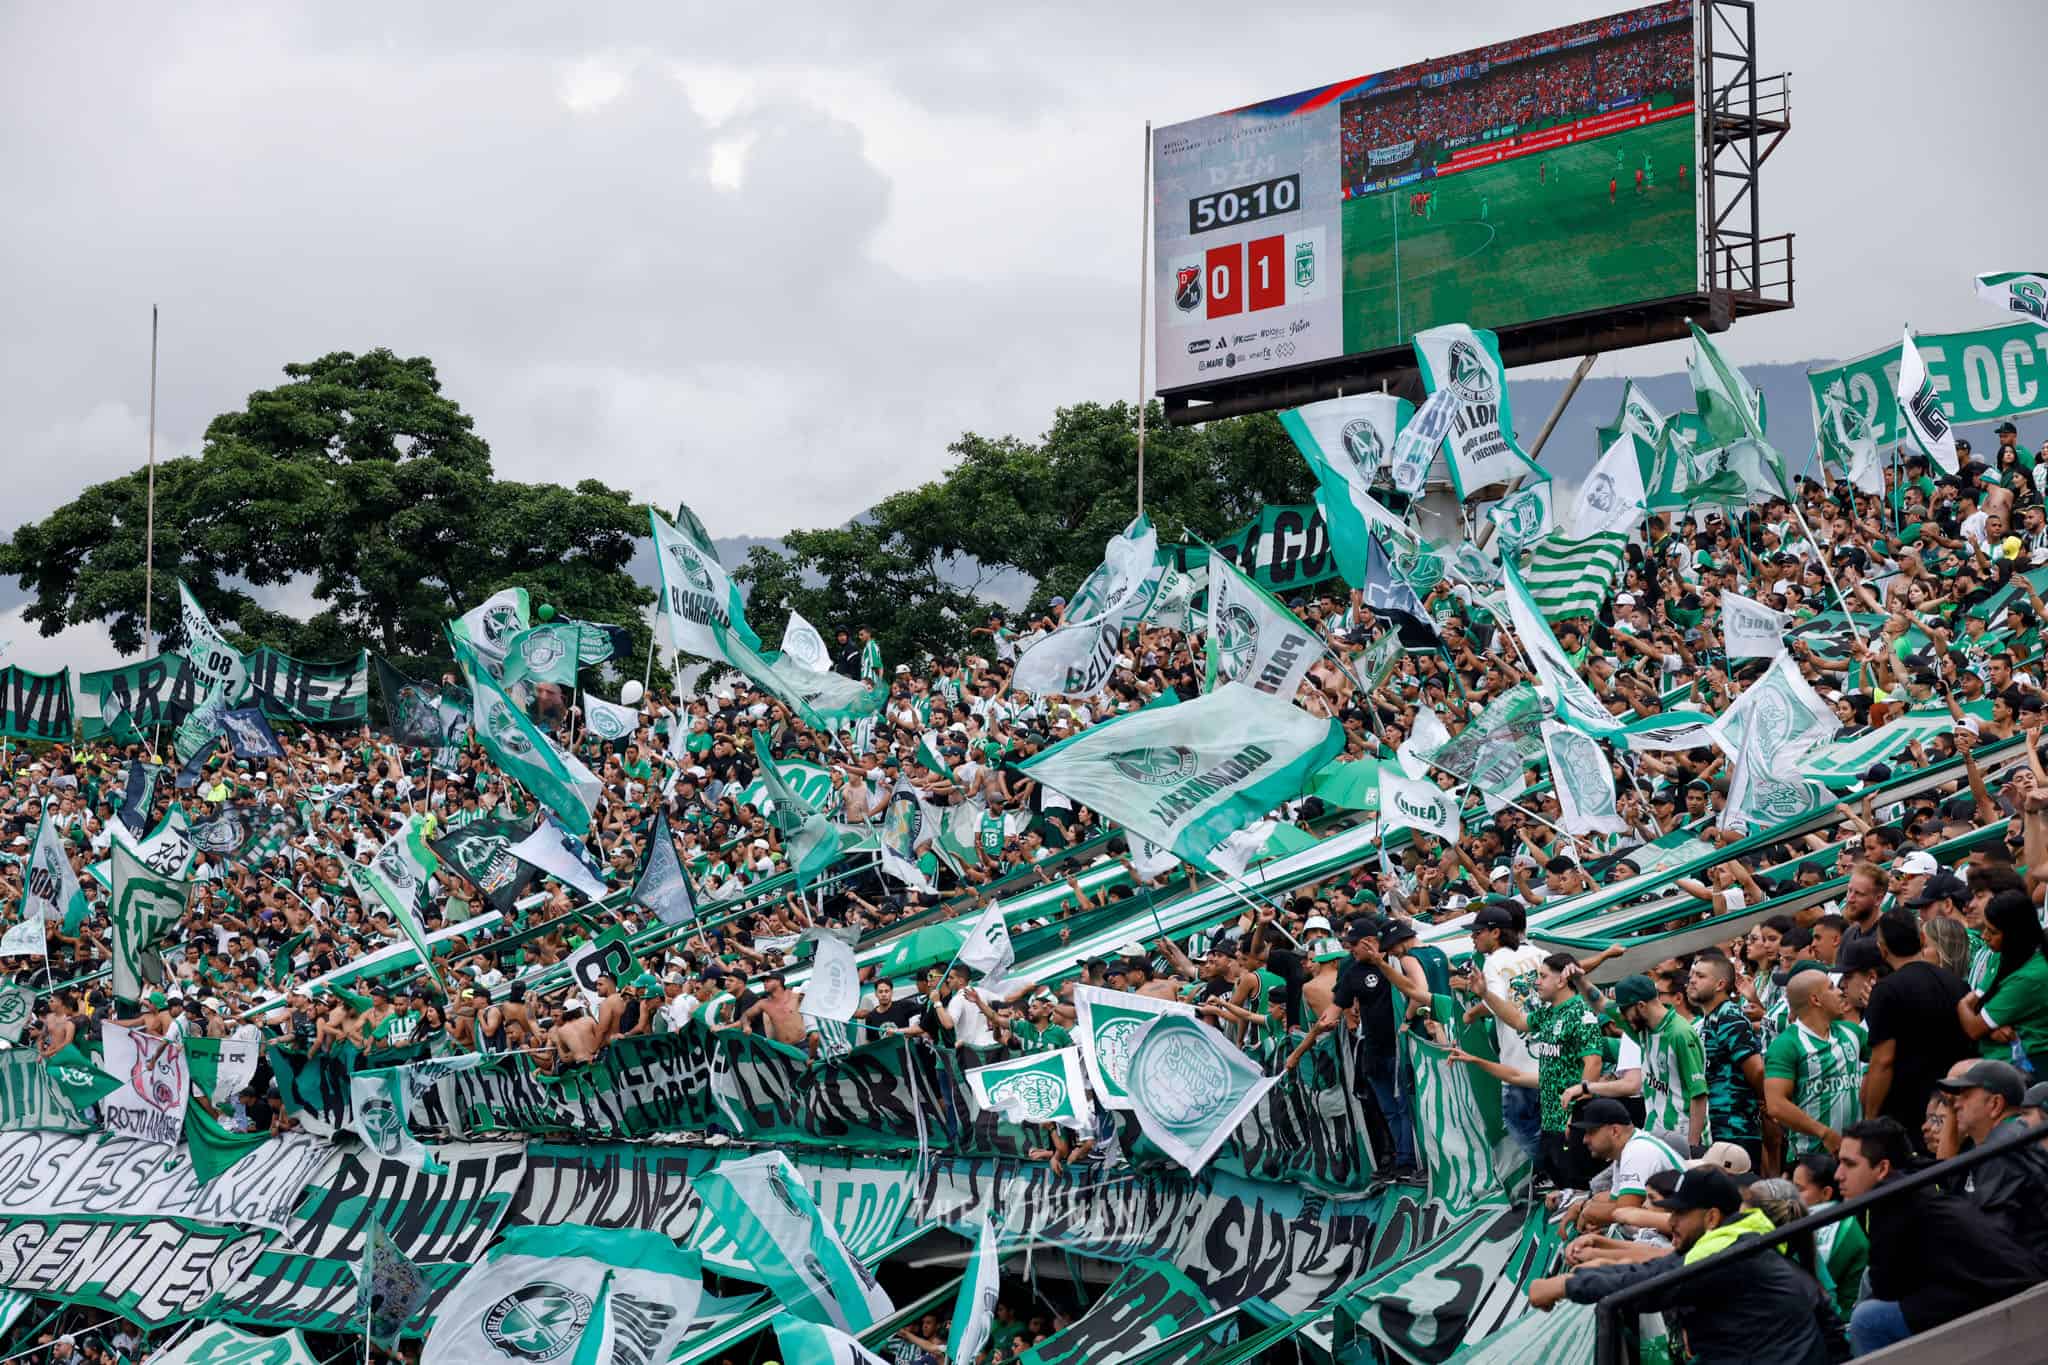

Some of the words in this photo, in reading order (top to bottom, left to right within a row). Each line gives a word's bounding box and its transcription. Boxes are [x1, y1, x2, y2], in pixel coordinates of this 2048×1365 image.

[1197, 180, 1295, 228] 50:10
[1211, 265, 1230, 300] 0
[1258, 255, 1270, 289] 1
[207, 651, 233, 677] 08
[1400, 799, 1438, 820] UDEA
[984, 832, 998, 847] 18
